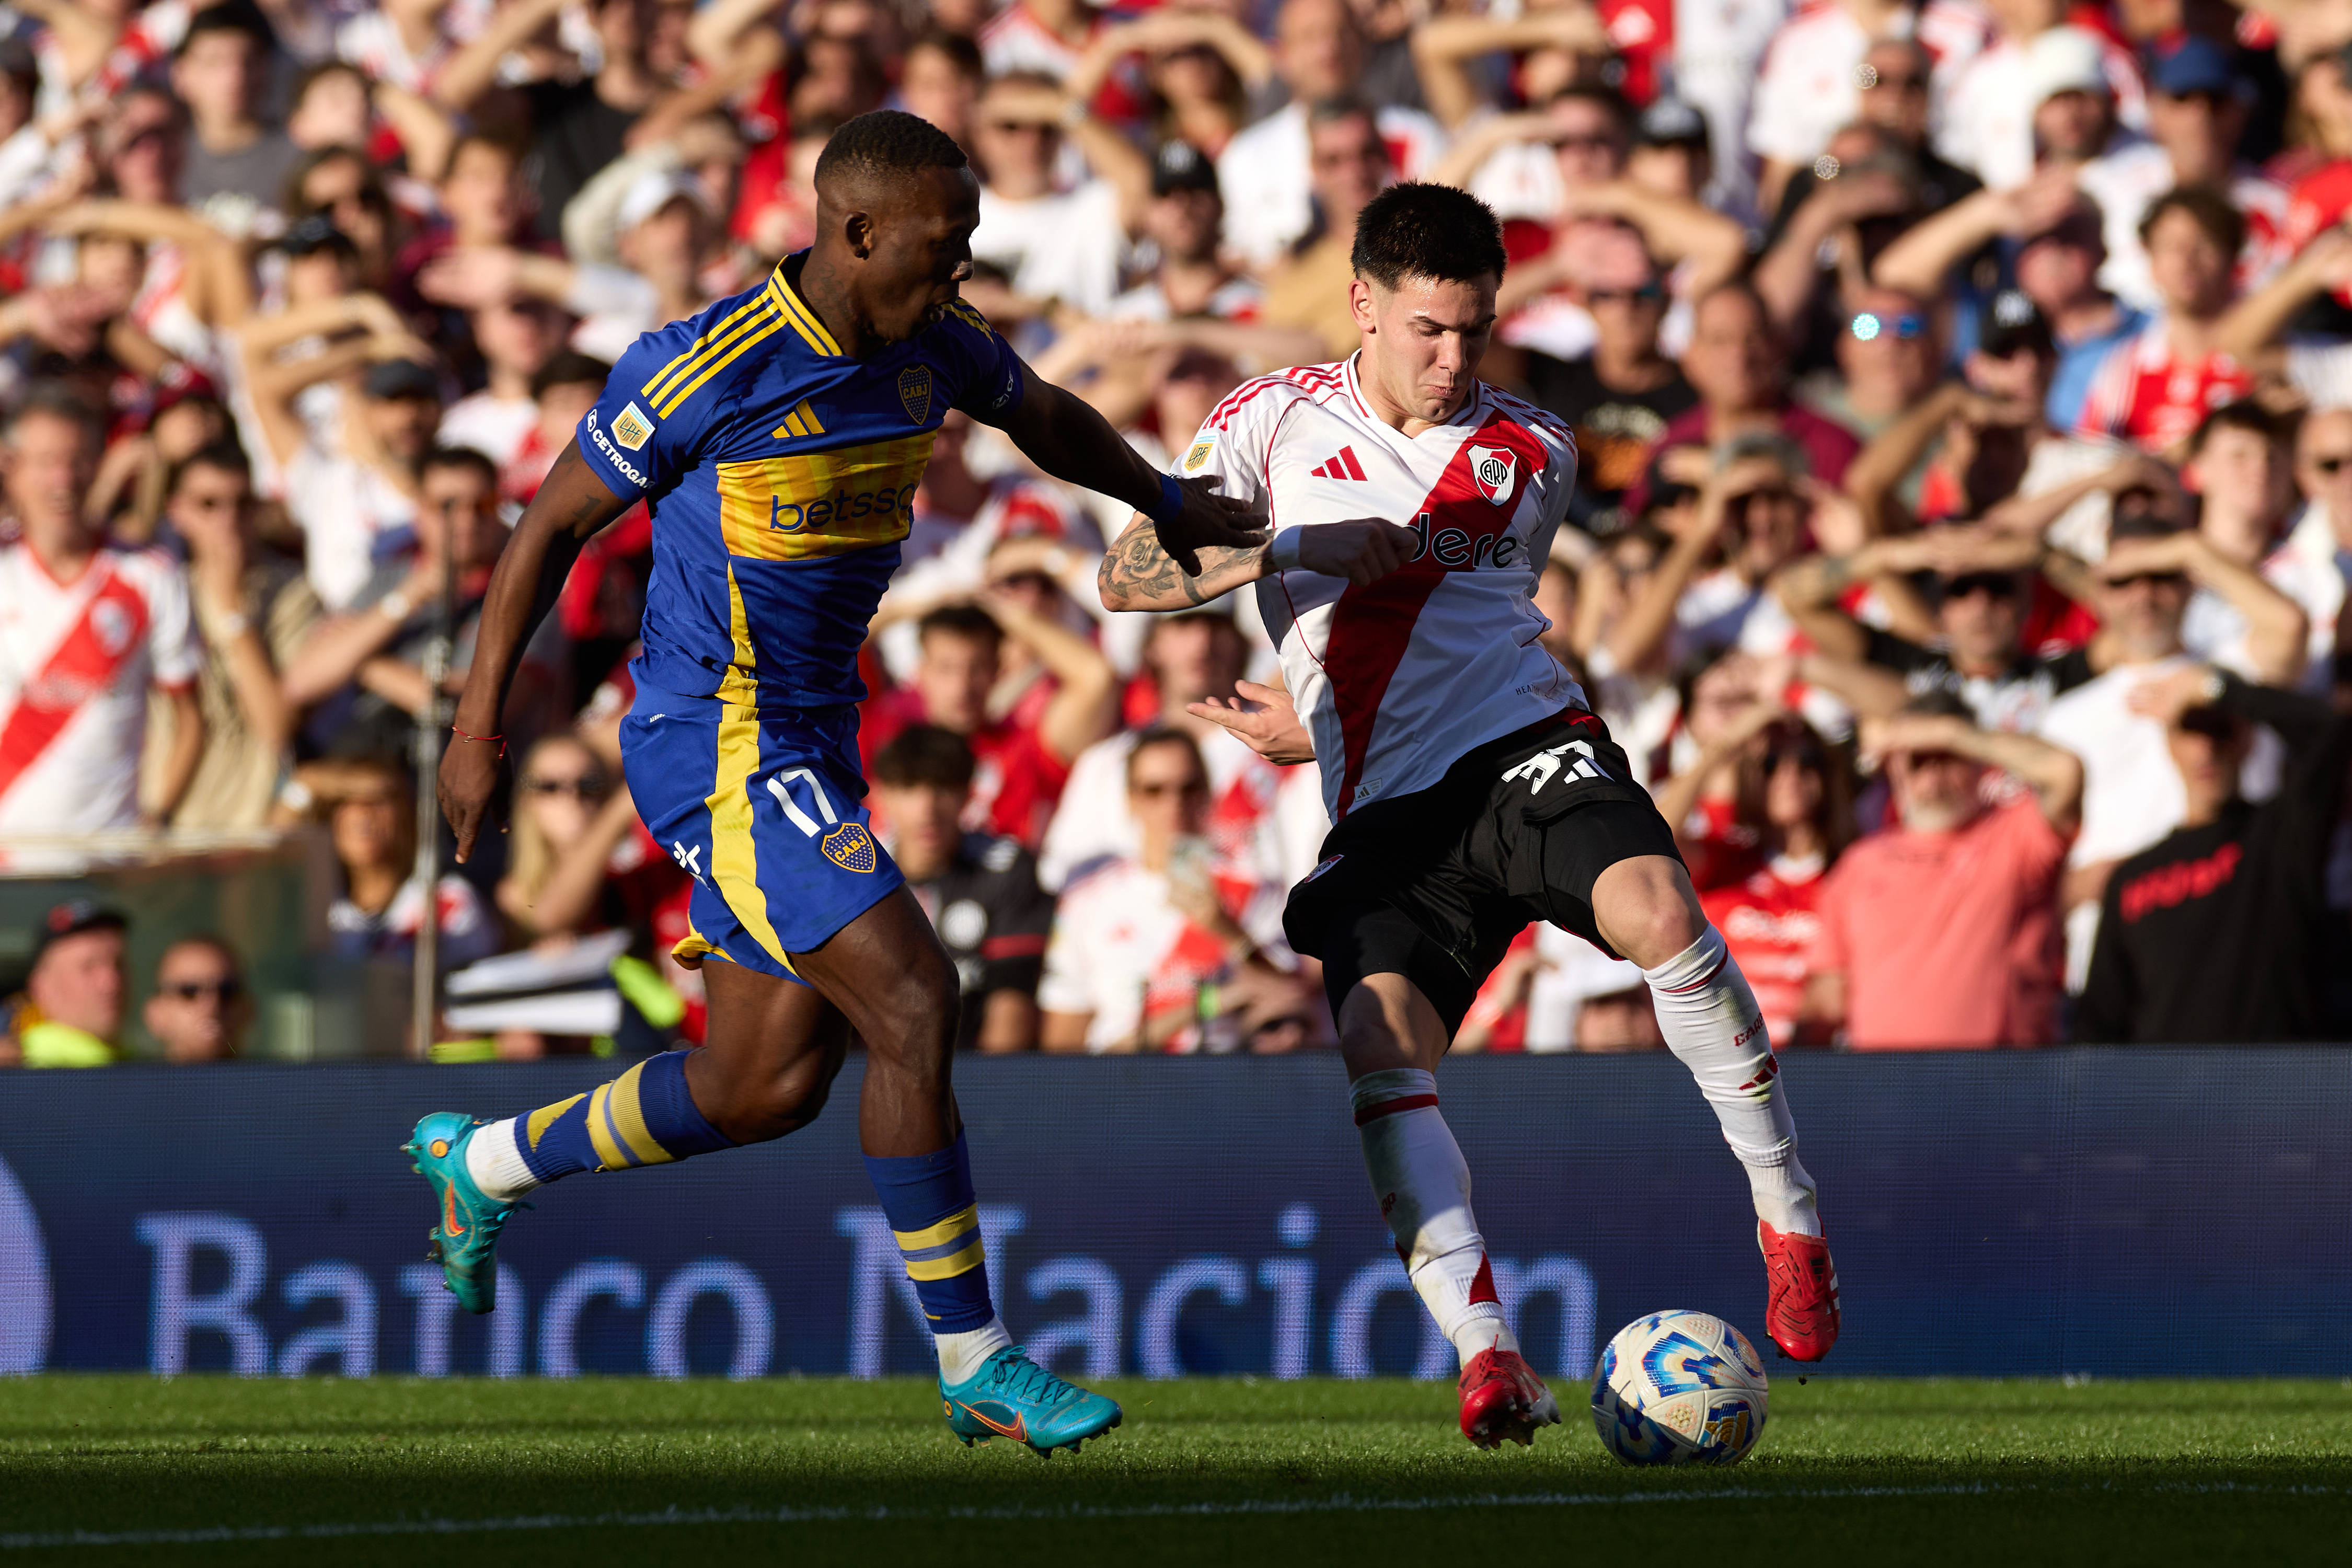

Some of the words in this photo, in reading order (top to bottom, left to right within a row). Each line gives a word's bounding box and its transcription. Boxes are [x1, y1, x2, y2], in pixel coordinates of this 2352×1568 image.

[903, 384, 928, 399] CABJ
[1480, 459, 1508, 486] CARP
[767, 765, 838, 838] 17
[835, 835, 867, 861] CABJ
[133, 1211, 776, 1378] Banco
